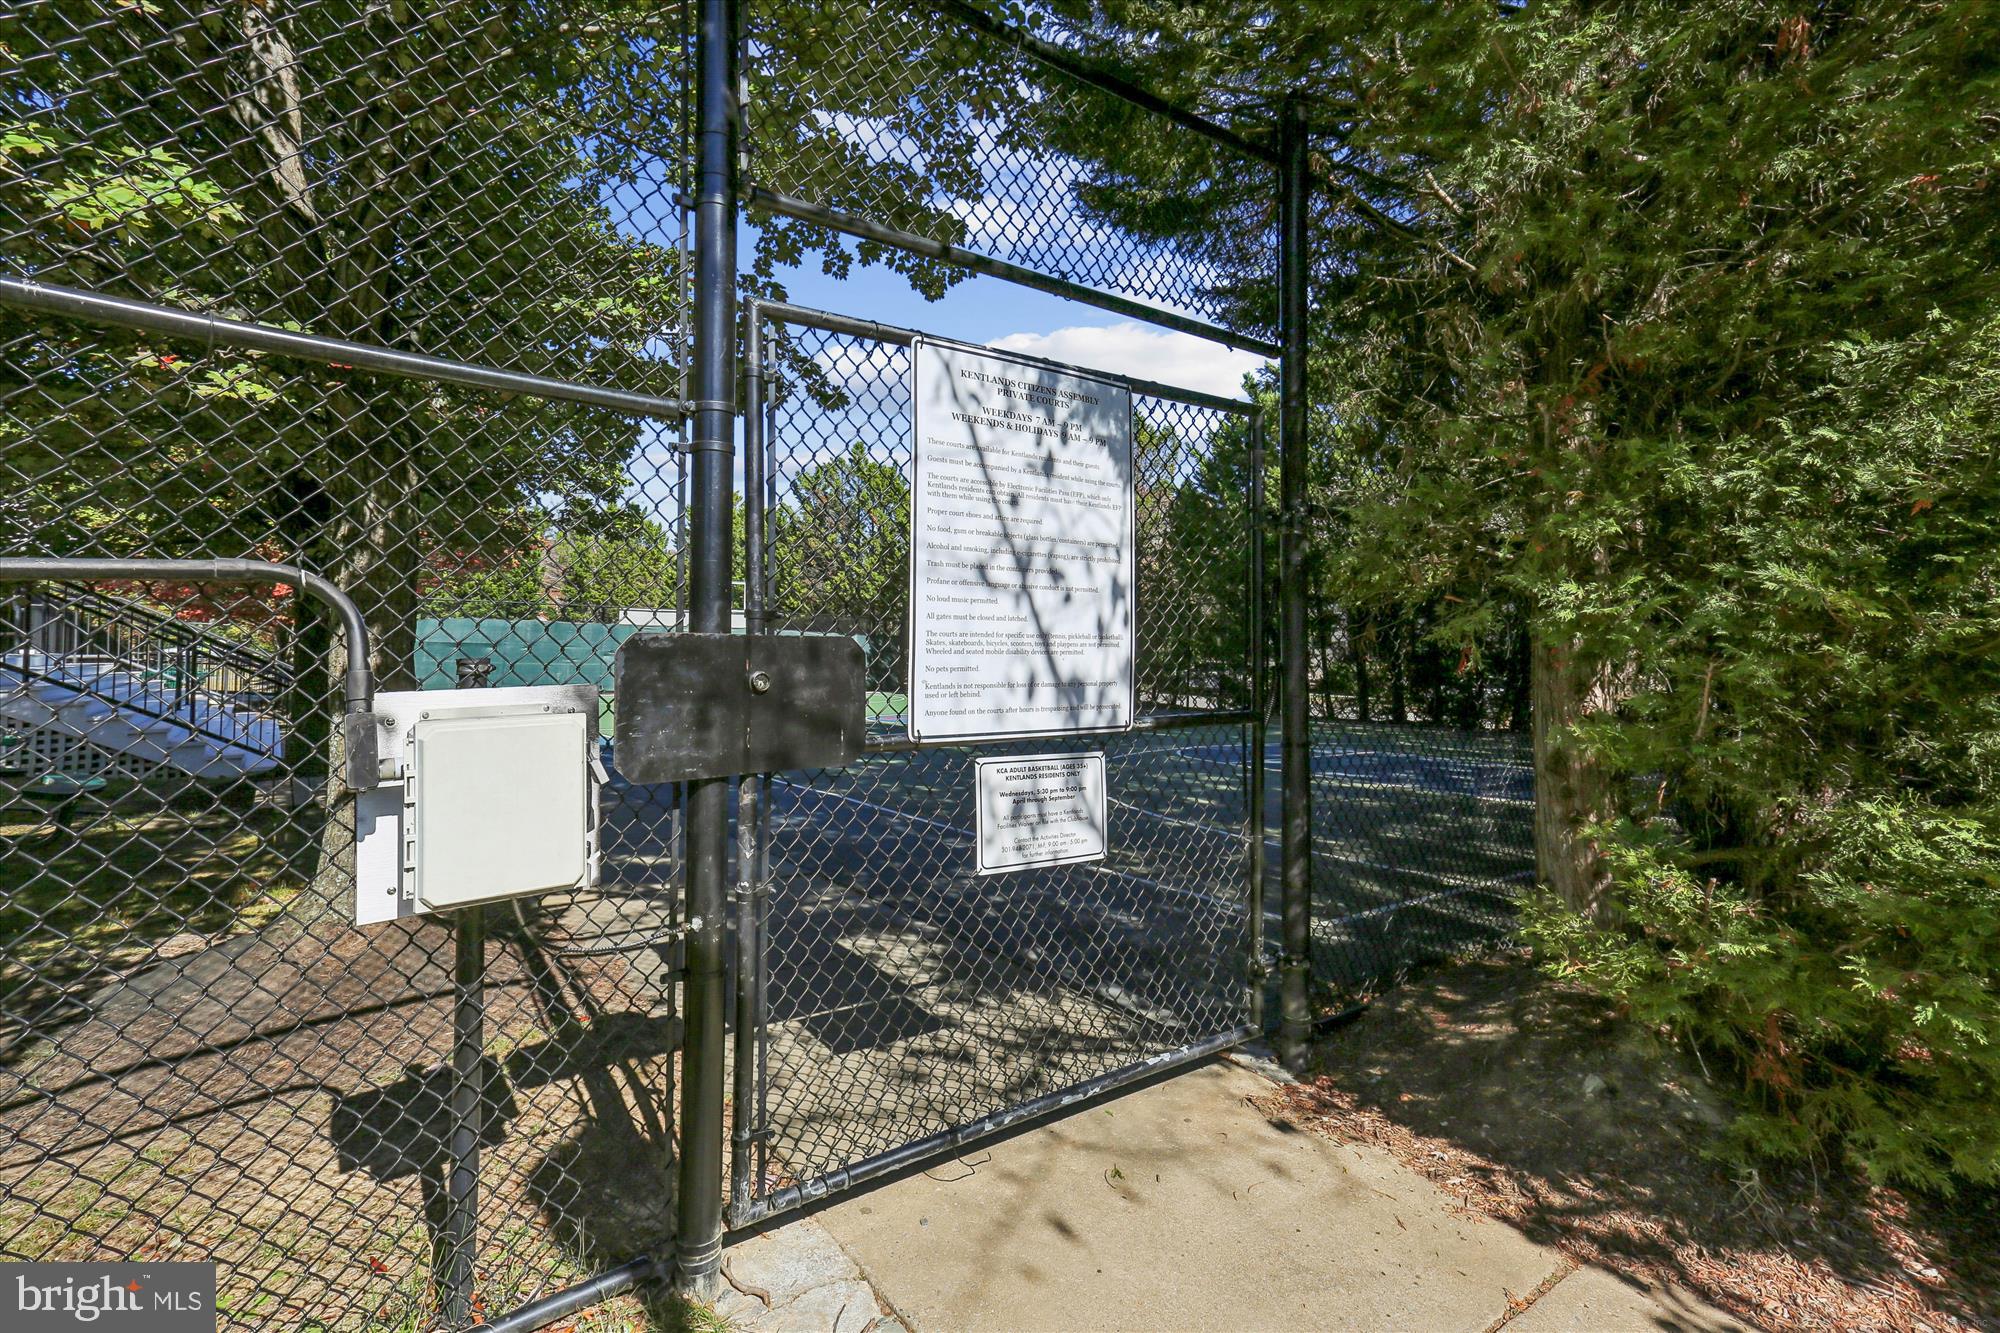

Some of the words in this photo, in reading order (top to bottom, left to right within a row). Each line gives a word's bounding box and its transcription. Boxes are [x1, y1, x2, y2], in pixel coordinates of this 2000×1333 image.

[961, 369, 1016, 388] KENTLANDS
[1018, 381, 1057, 396] CITIZENS
[1058, 390, 1099, 405] ASSEMBLY
[997, 388, 1034, 402] PRIVATE
[1034, 395, 1070, 409] COURTS
[983, 406, 1033, 423] WEEKDAYS
[1036, 416, 1040, 424] 7
[1042, 418, 1055, 427] AM
[1062, 421, 1069, 429] 9
[1070, 423, 1082, 432] PM
[952, 412, 1005, 429] WEEKENDS
[1007, 422, 1013, 430] &
[1015, 423, 1059, 438] HOLIDAYS
[1062, 431, 1067, 439] 9
[1068, 433, 1081, 442] AM
[1089, 436, 1093, 444] 9
[1095, 438, 1106, 446] PM
[927, 437, 945, 446] These
[1011, 450, 1038, 460] Kentlands
[927, 454, 948, 463] Guests
[1011, 467, 1017, 475] by
[927, 472, 939, 480] The
[999, 482, 1006, 490] by
[927, 480, 957, 490] Kentlands
[958, 486, 985, 494] residents
[1026, 494, 1049, 502] residents
[942, 491, 957, 499] them
[959, 493, 975, 501] while
[976, 496, 991, 504] using
[927, 507, 947, 516] Proper
[937, 525, 952, 534] food,
[927, 542, 950, 550] Alcohol
[927, 559, 945, 567] Trash
[926, 577, 950, 585] Profane
[959, 579, 987, 587] offensive
[936, 613, 952, 621] gates
[1005, 632, 1025, 640] specific
[936, 666, 948, 674] pets
[974, 682, 1007, 690] responsible
[925, 710, 948, 718] Anyone
[1013, 798, 1026, 806] April
[1027, 796, 1048, 804] through
[1048, 794, 1076, 802] September
